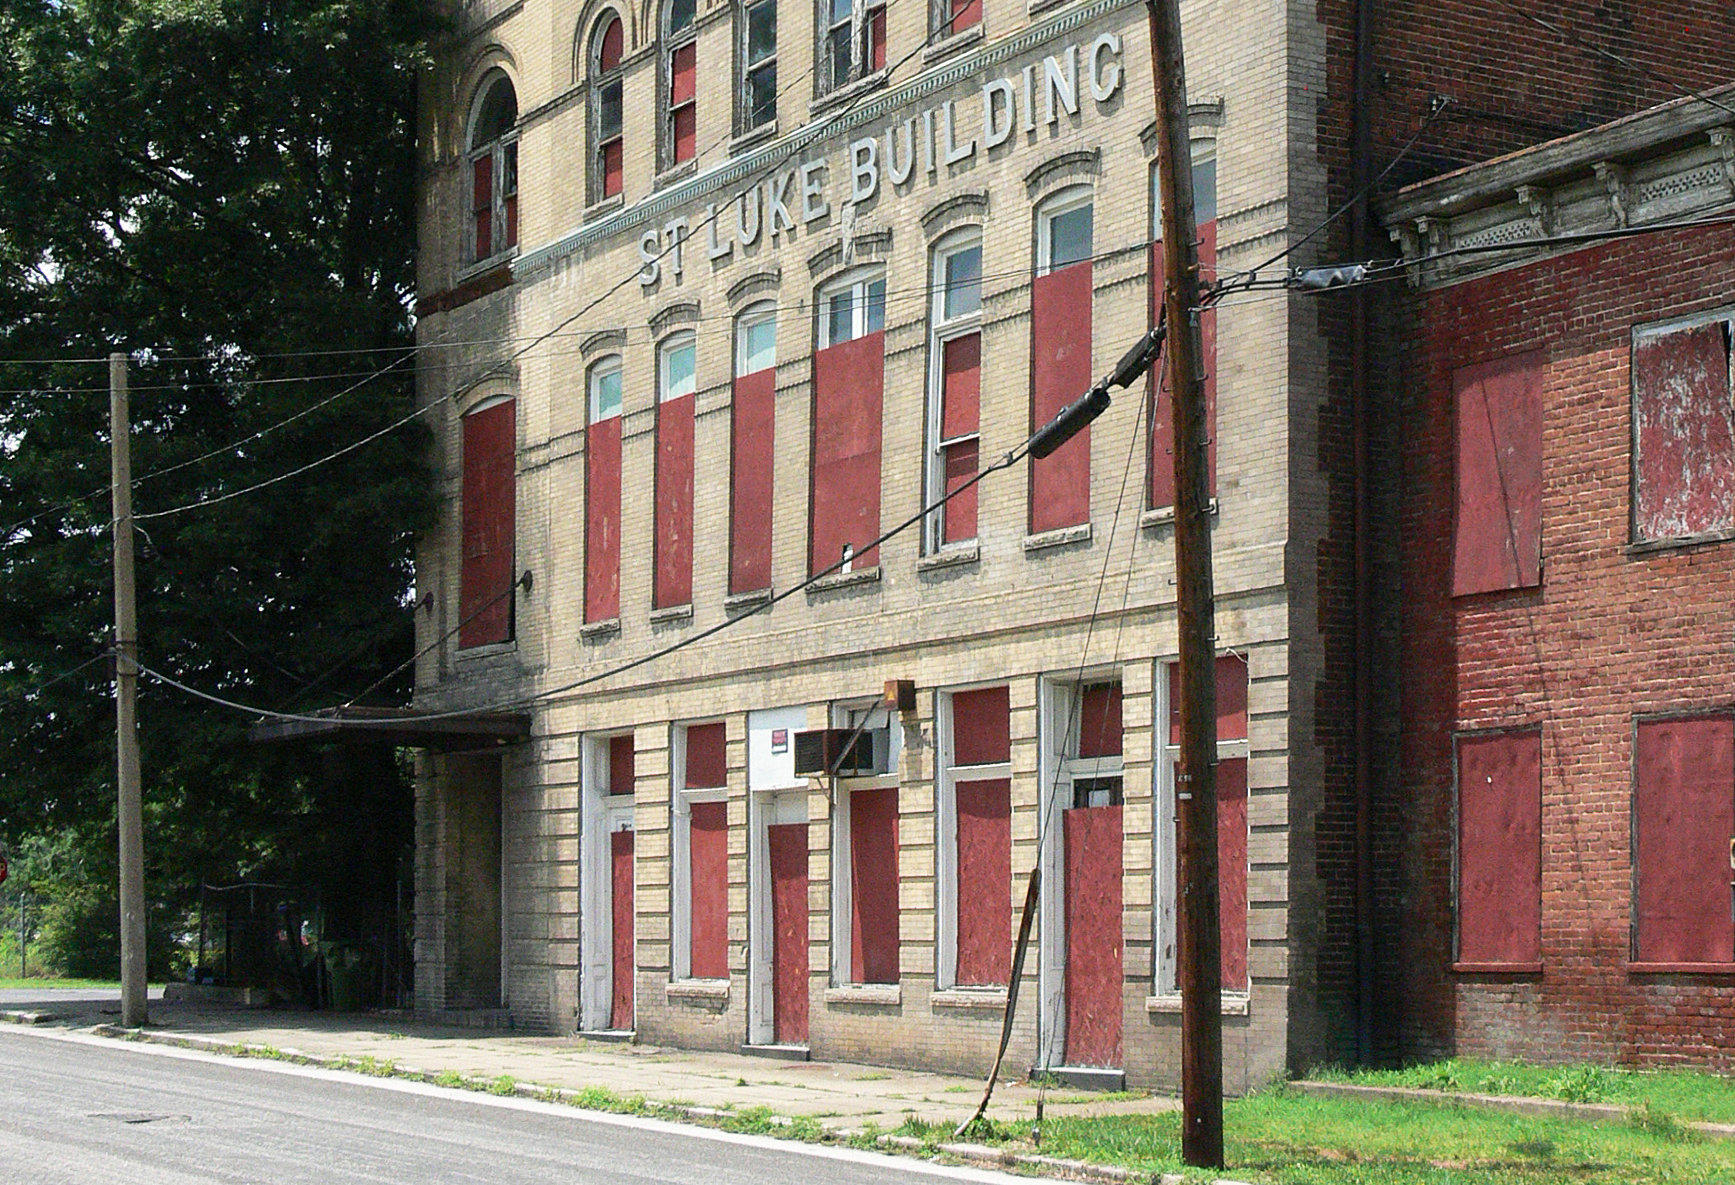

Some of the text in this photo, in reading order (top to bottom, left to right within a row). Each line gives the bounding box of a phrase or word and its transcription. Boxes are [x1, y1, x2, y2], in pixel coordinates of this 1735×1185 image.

[638, 32, 1124, 286] ST LUKE BUILDING
